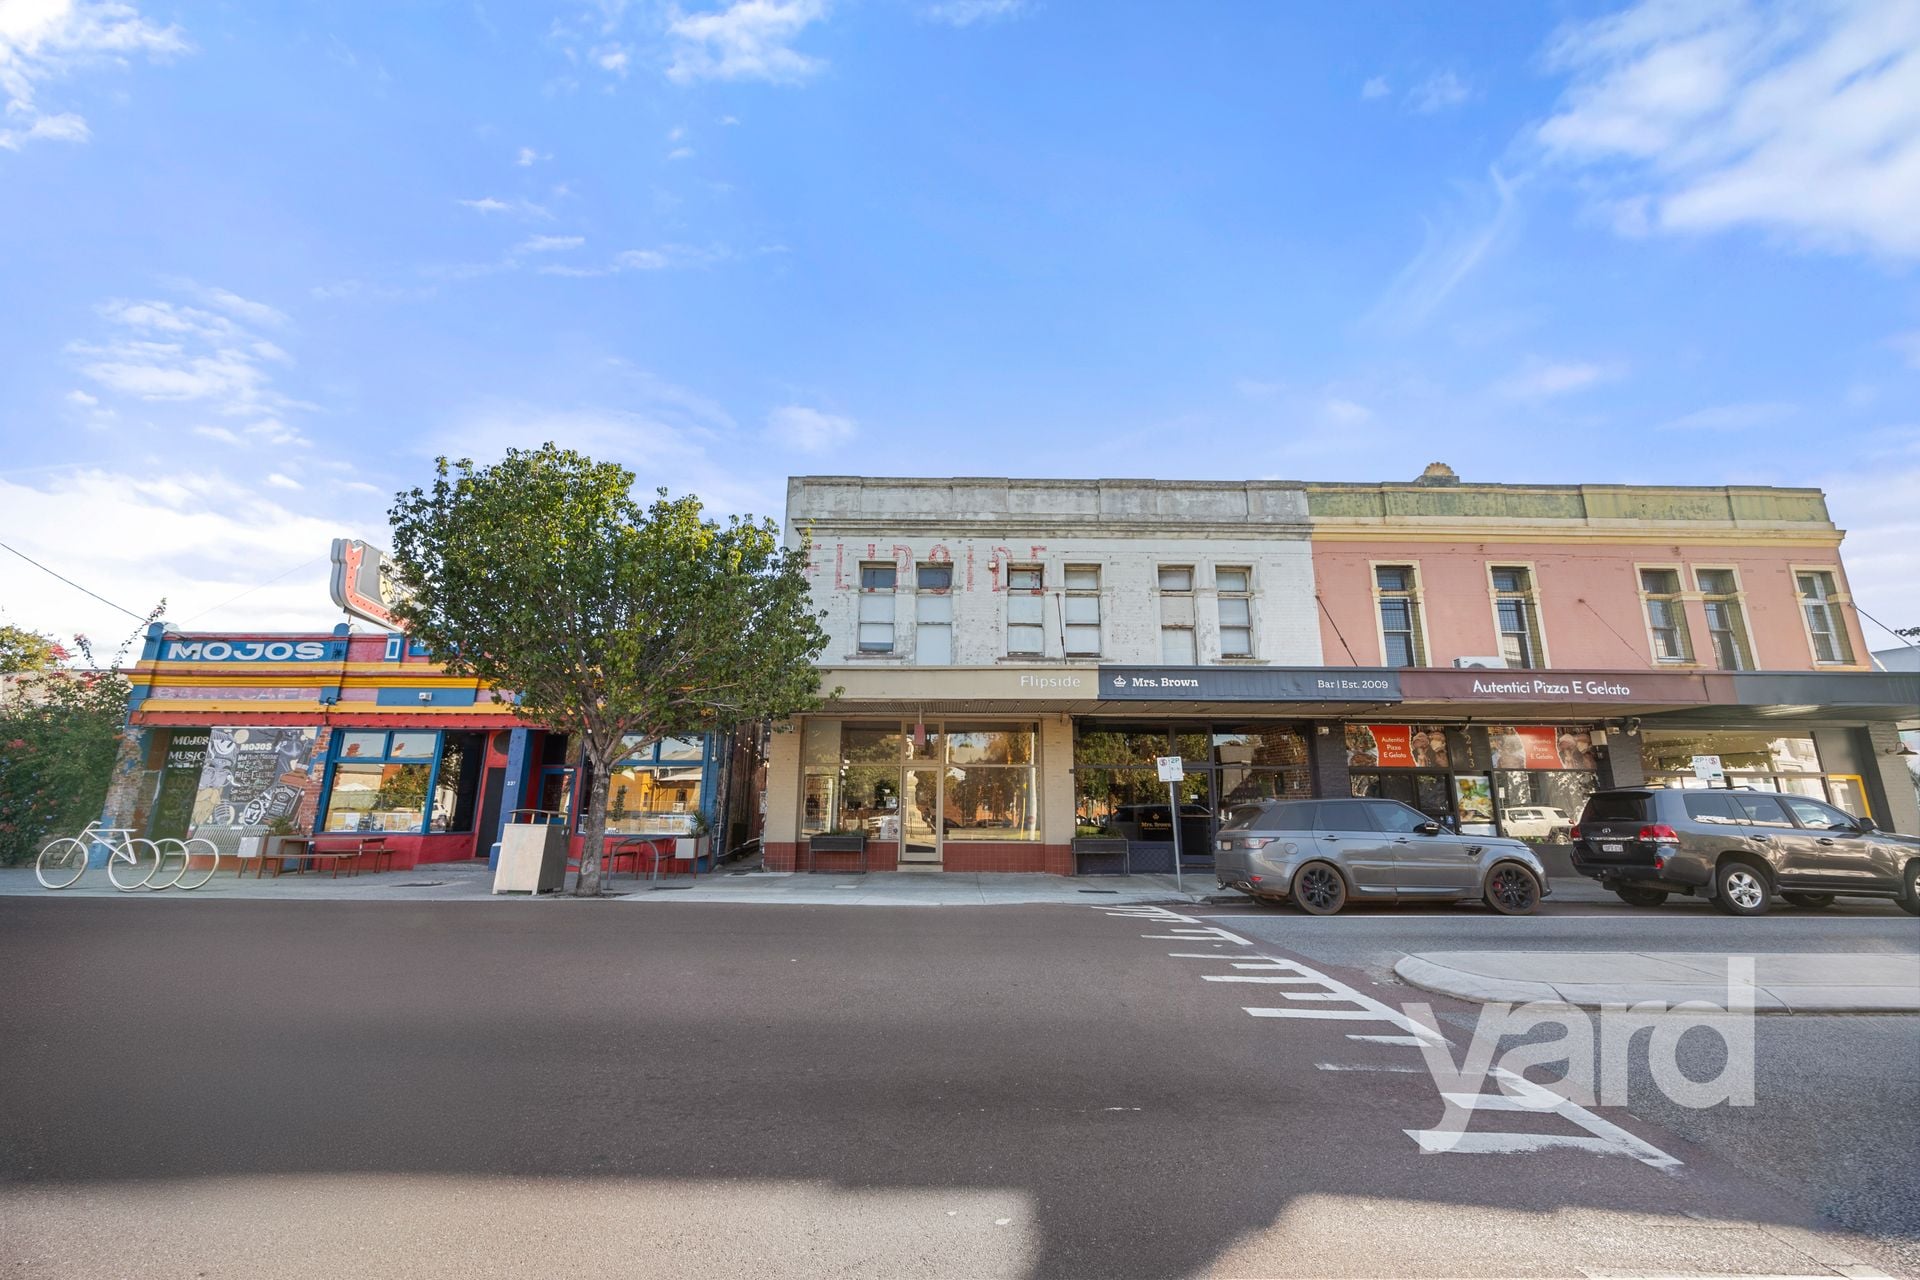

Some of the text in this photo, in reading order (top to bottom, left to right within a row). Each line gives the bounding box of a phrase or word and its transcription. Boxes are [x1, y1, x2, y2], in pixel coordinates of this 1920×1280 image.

[168, 642, 325, 660] MOJOS
[1020, 675, 1081, 689] Flipside
[1132, 677, 1199, 687] Mrs. Brown
[1317, 680, 1388, 689] Bar Est. 2009
[1473, 680, 1630, 696] Autentici Pizza E Gelato
[172, 735, 209, 746] MOJOS
[240, 743, 272, 751] MOJOS
[168, 751, 206, 762] MUSIC
